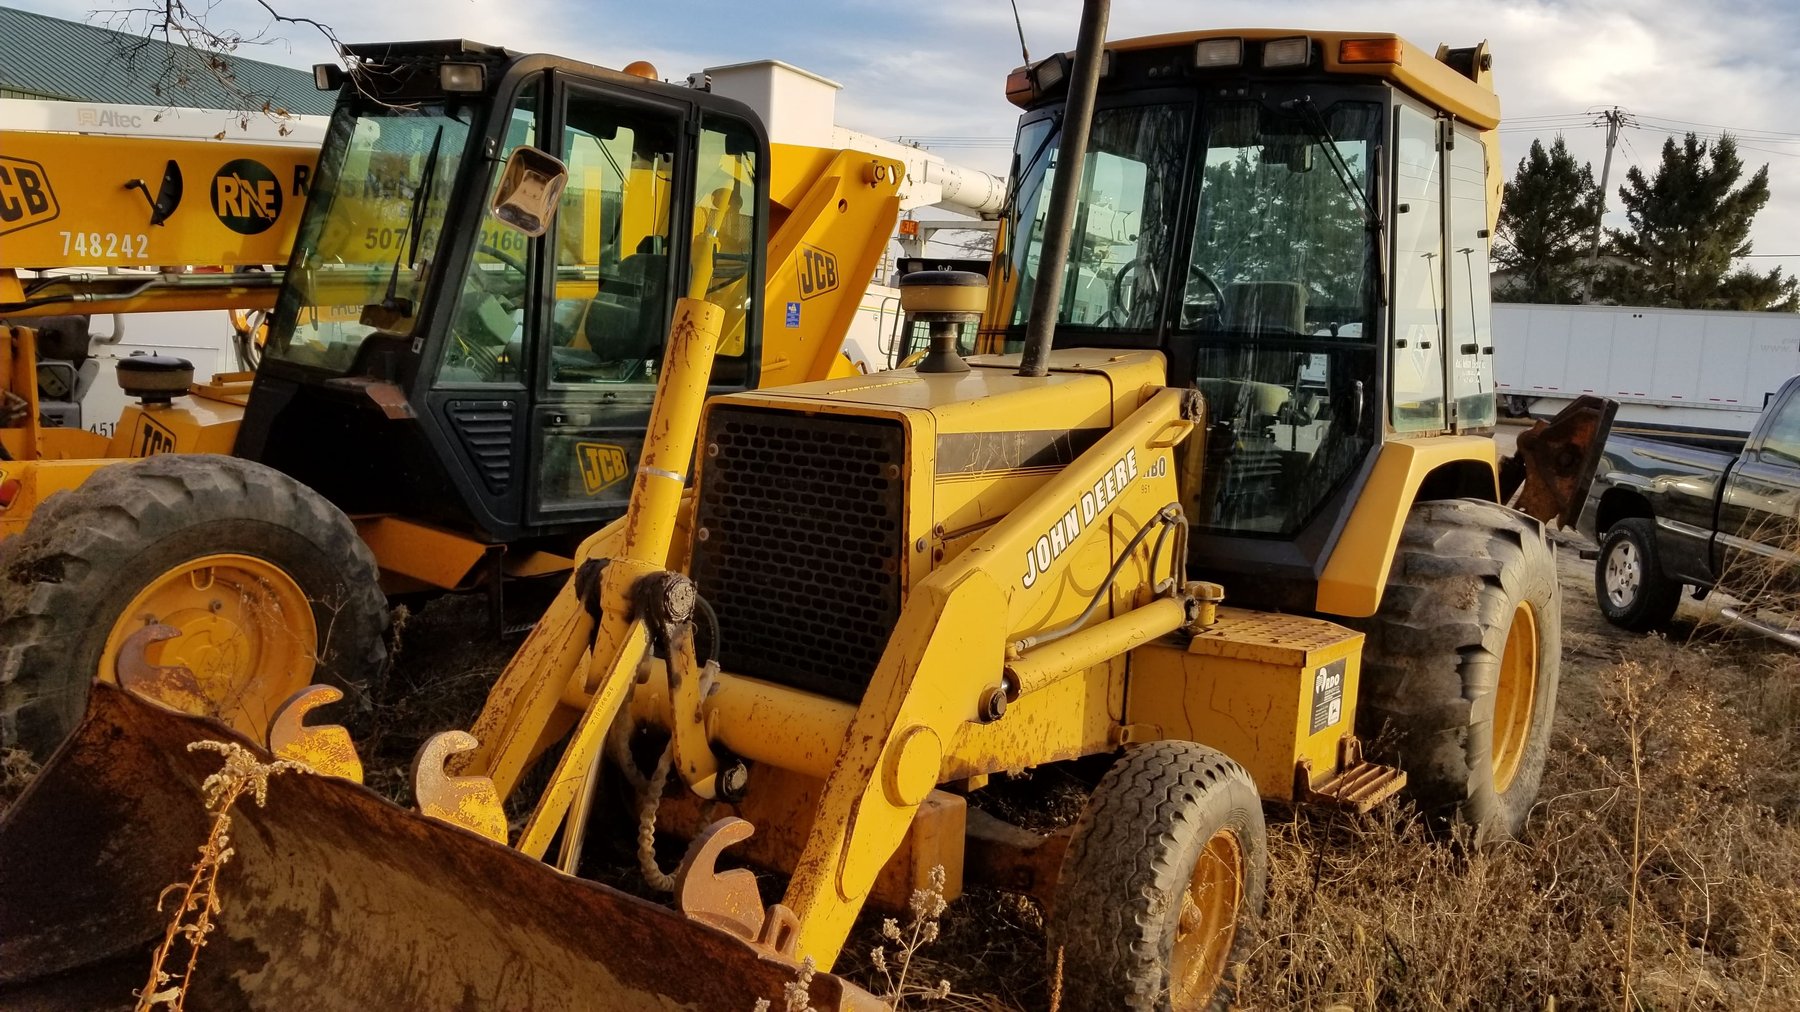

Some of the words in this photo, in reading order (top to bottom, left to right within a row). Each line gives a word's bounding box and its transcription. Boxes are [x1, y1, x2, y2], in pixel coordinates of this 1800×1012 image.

[99, 109, 142, 129] Altec
[217, 175, 276, 219] RNE
[60, 231, 148, 259] 748242
[802, 248, 836, 295] JCB
[585, 447, 625, 489] JCB
[1143, 456, 1166, 478] BO
[1022, 504, 1081, 589] JOHN
[1080, 446, 1138, 530] DEERE
